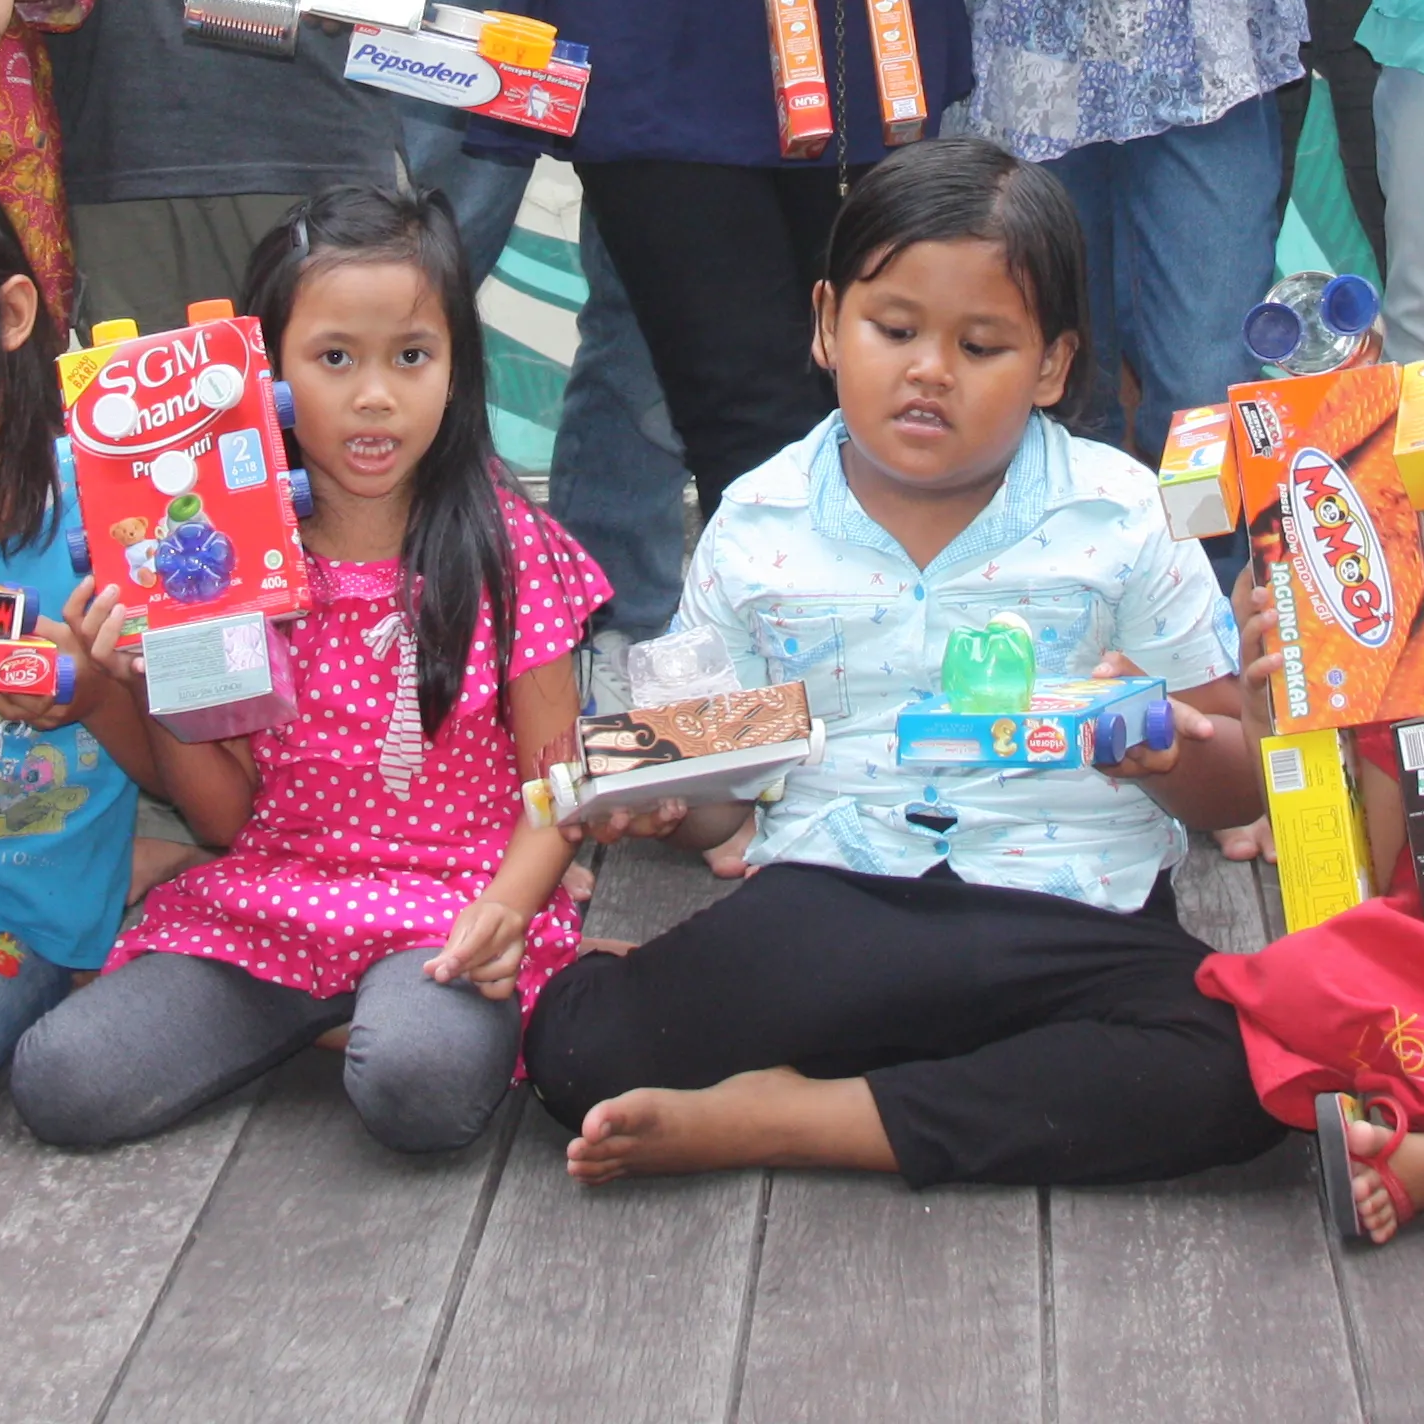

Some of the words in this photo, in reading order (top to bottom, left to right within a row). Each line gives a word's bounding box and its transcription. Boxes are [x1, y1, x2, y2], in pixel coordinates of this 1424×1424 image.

[353, 43, 480, 89] Pepsodent
[794, 95, 820, 106] SUN
[73, 360, 98, 389] BARU
[97, 329, 211, 398] SGM
[233, 435, 251, 463] 2
[260, 575, 288, 590] 400g
[1270, 561, 1299, 642] JAGUNG
[4, 667, 38, 683] SGM
[1281, 644, 1310, 718] BAKAR
[1029, 738, 1066, 749] vidoran
